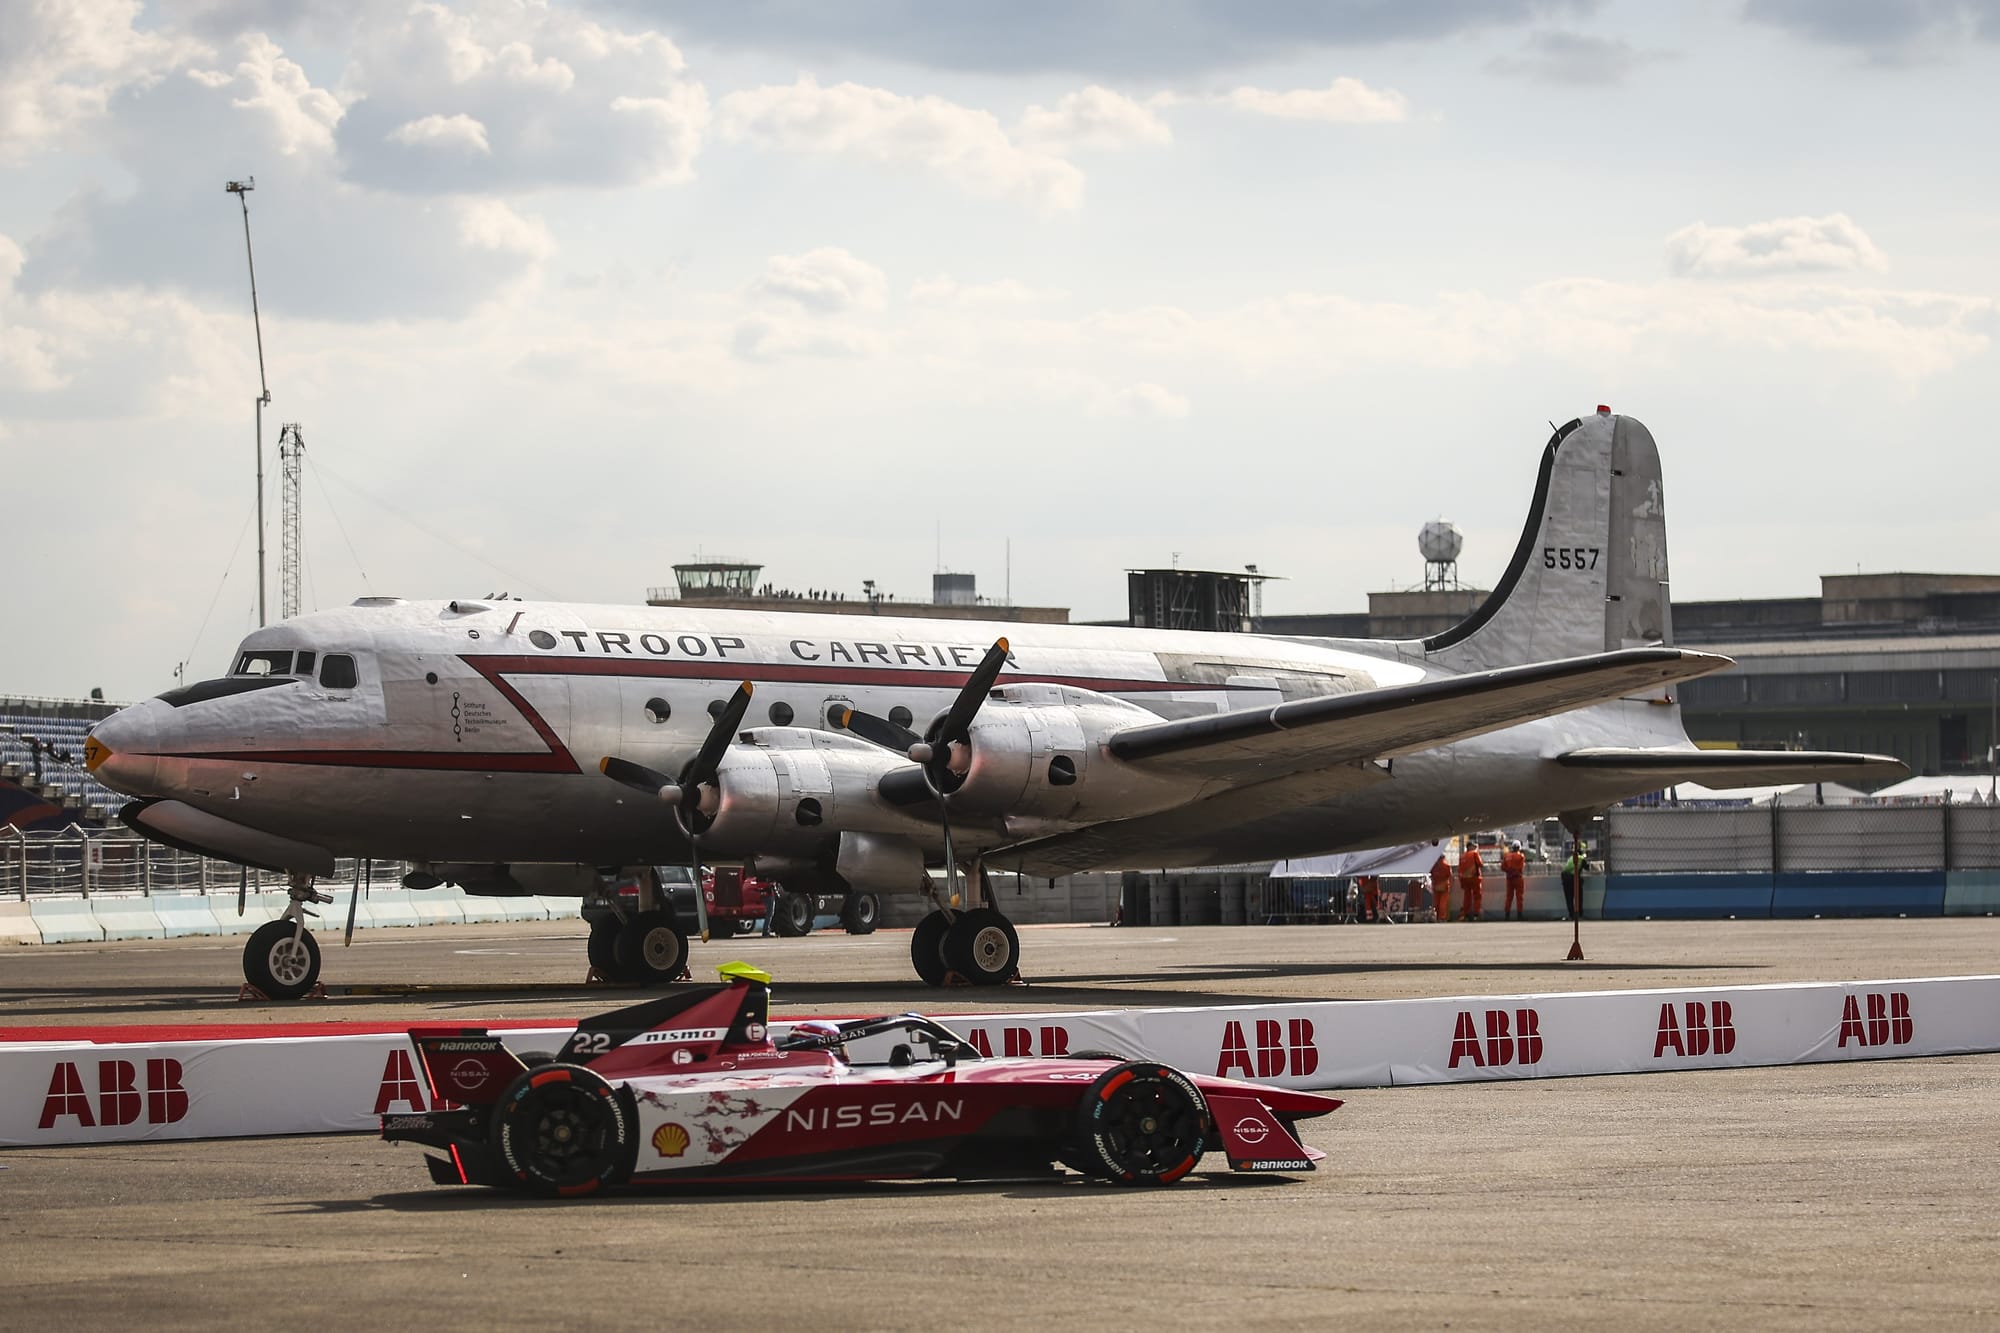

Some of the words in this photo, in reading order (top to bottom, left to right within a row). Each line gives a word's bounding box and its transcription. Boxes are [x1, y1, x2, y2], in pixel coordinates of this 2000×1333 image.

[1544, 547, 1599, 570] 5557
[560, 630, 745, 658] TROOP
[1653, 1000, 1737, 1058] ABB
[1839, 993, 1914, 1047] ABB
[574, 1033, 611, 1053] 22
[817, 1029, 866, 1045] NISSAN
[1217, 1018, 1319, 1079] ABB
[1447, 1008, 1544, 1069] ABB
[450, 1070, 490, 1078] NISSAN
[38, 1058, 189, 1129] ABB
[787, 1100, 963, 1132] NISSAN
